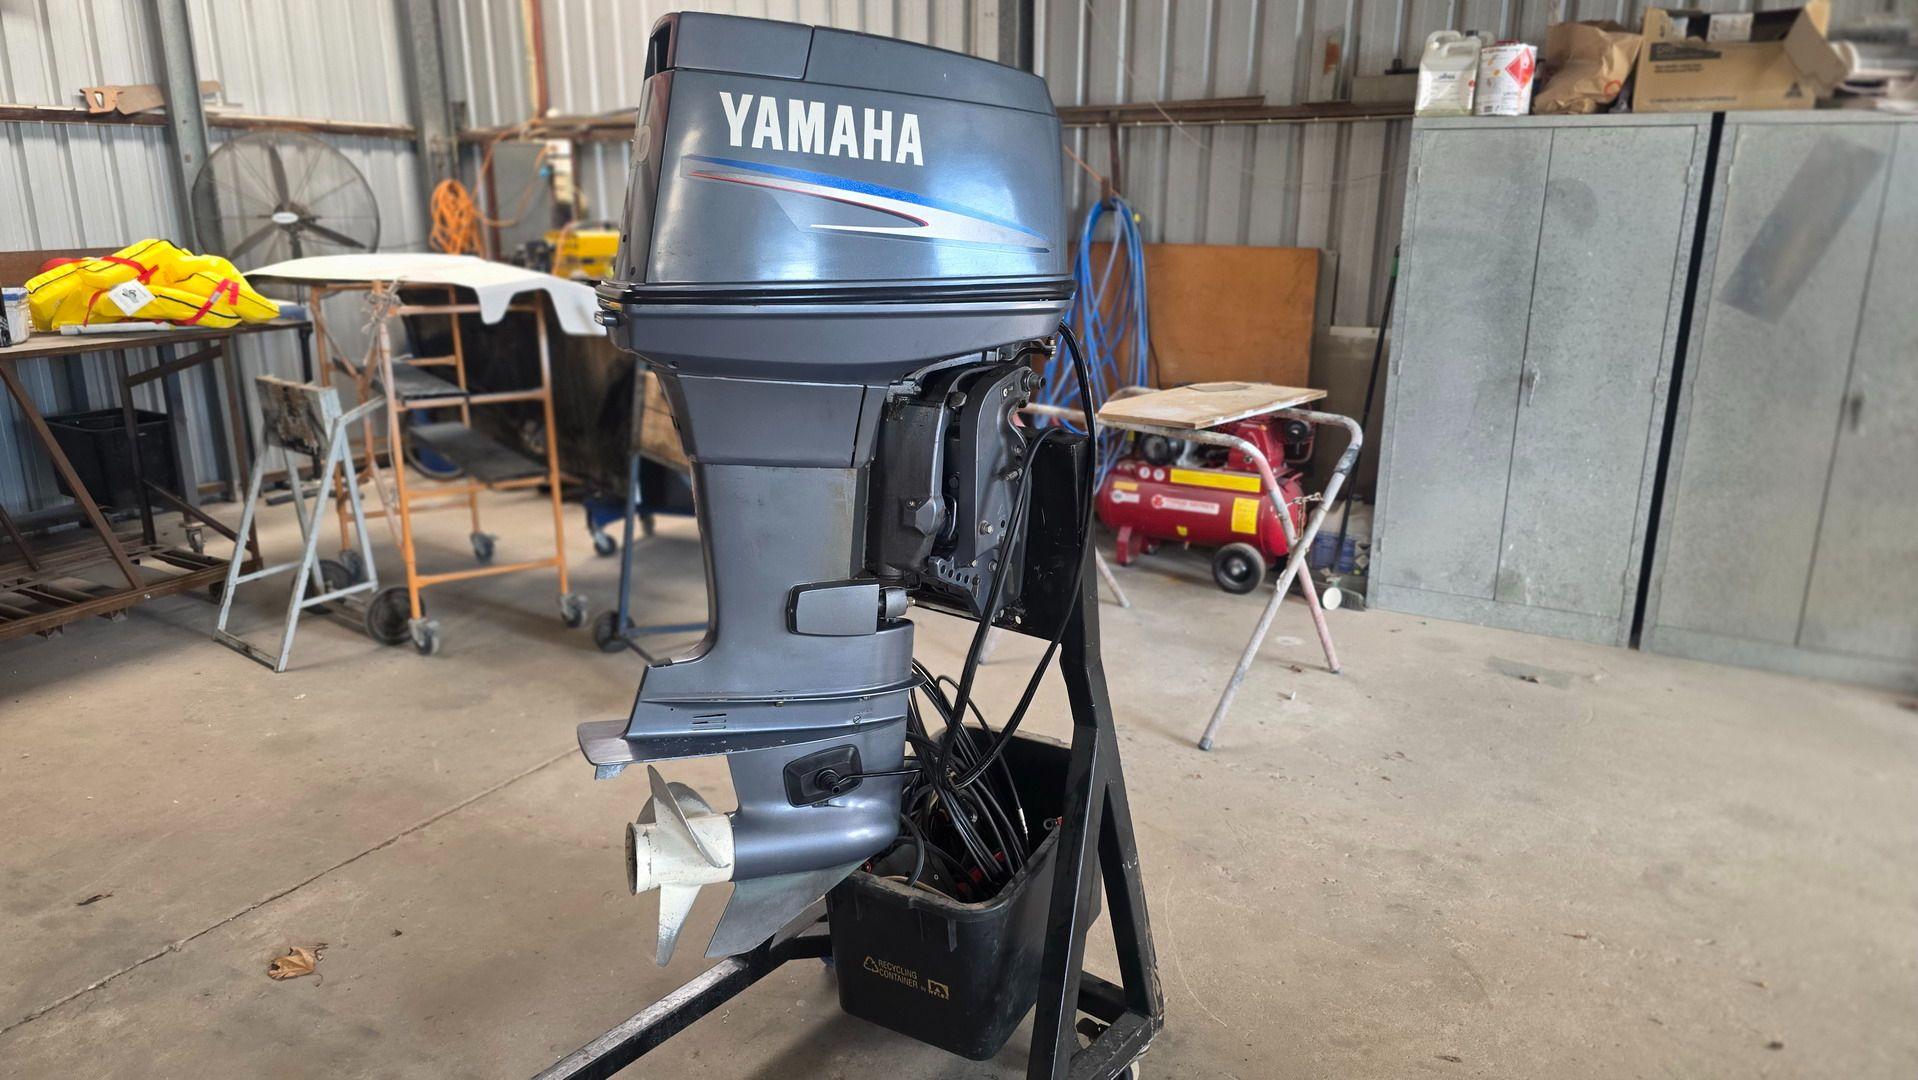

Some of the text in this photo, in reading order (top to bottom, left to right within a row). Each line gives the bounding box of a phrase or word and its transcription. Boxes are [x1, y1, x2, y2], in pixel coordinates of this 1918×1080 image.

[719, 91, 924, 167] YAMAHA
[878, 960, 918, 979] RECYCLING
[879, 968, 919, 989] CONTAINER
